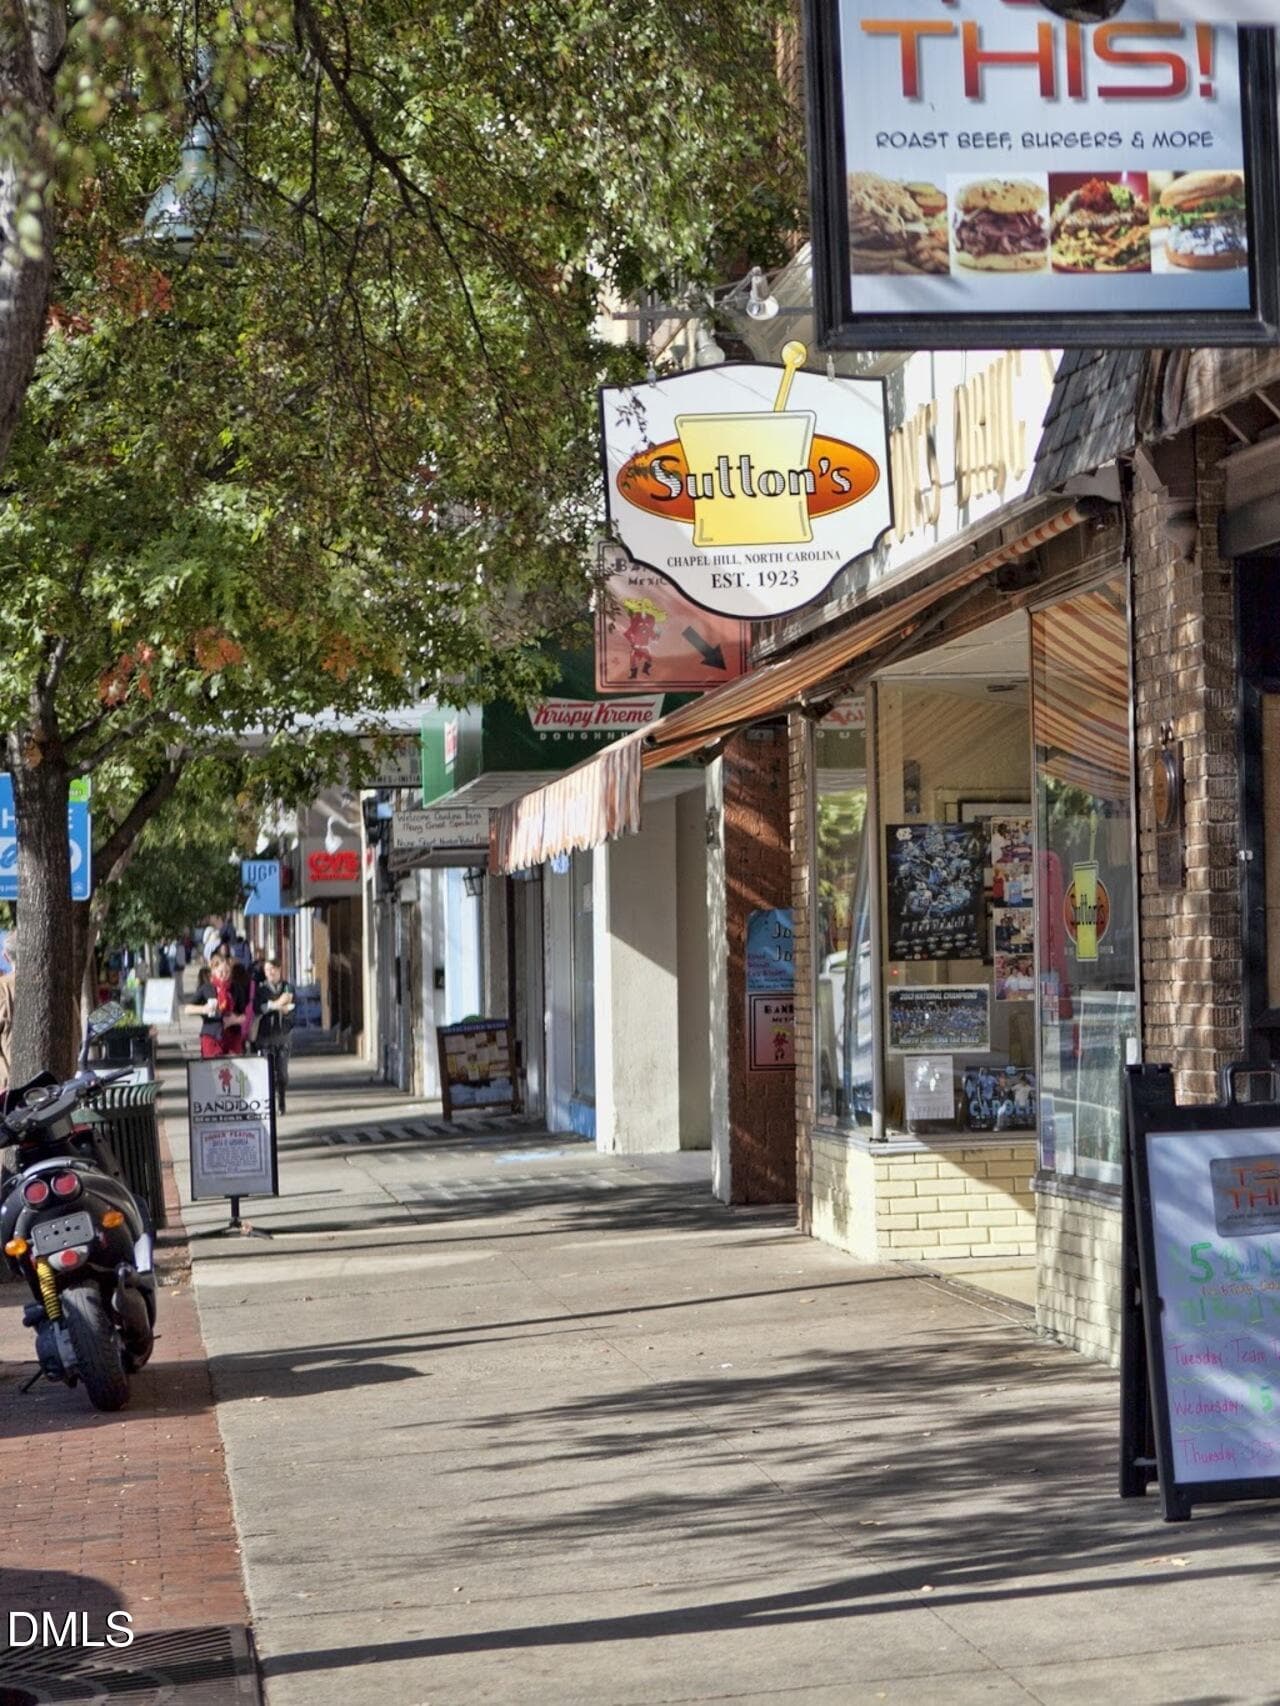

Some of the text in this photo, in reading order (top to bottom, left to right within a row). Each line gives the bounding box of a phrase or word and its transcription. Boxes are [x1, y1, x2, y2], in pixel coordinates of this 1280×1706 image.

[860, 19, 1215, 99] THIS!
[875, 130, 1215, 151] ROAST BEEF, BURGERS & MORE
[650, 454, 853, 501] Sutton's
[666, 556, 711, 568] CHAPEL
[745, 552, 784, 565] NORTH
[787, 550, 841, 563] CAROLINA
[711, 570, 799, 589] EST. 1923
[534, 701, 655, 728] Krispy Kreme
